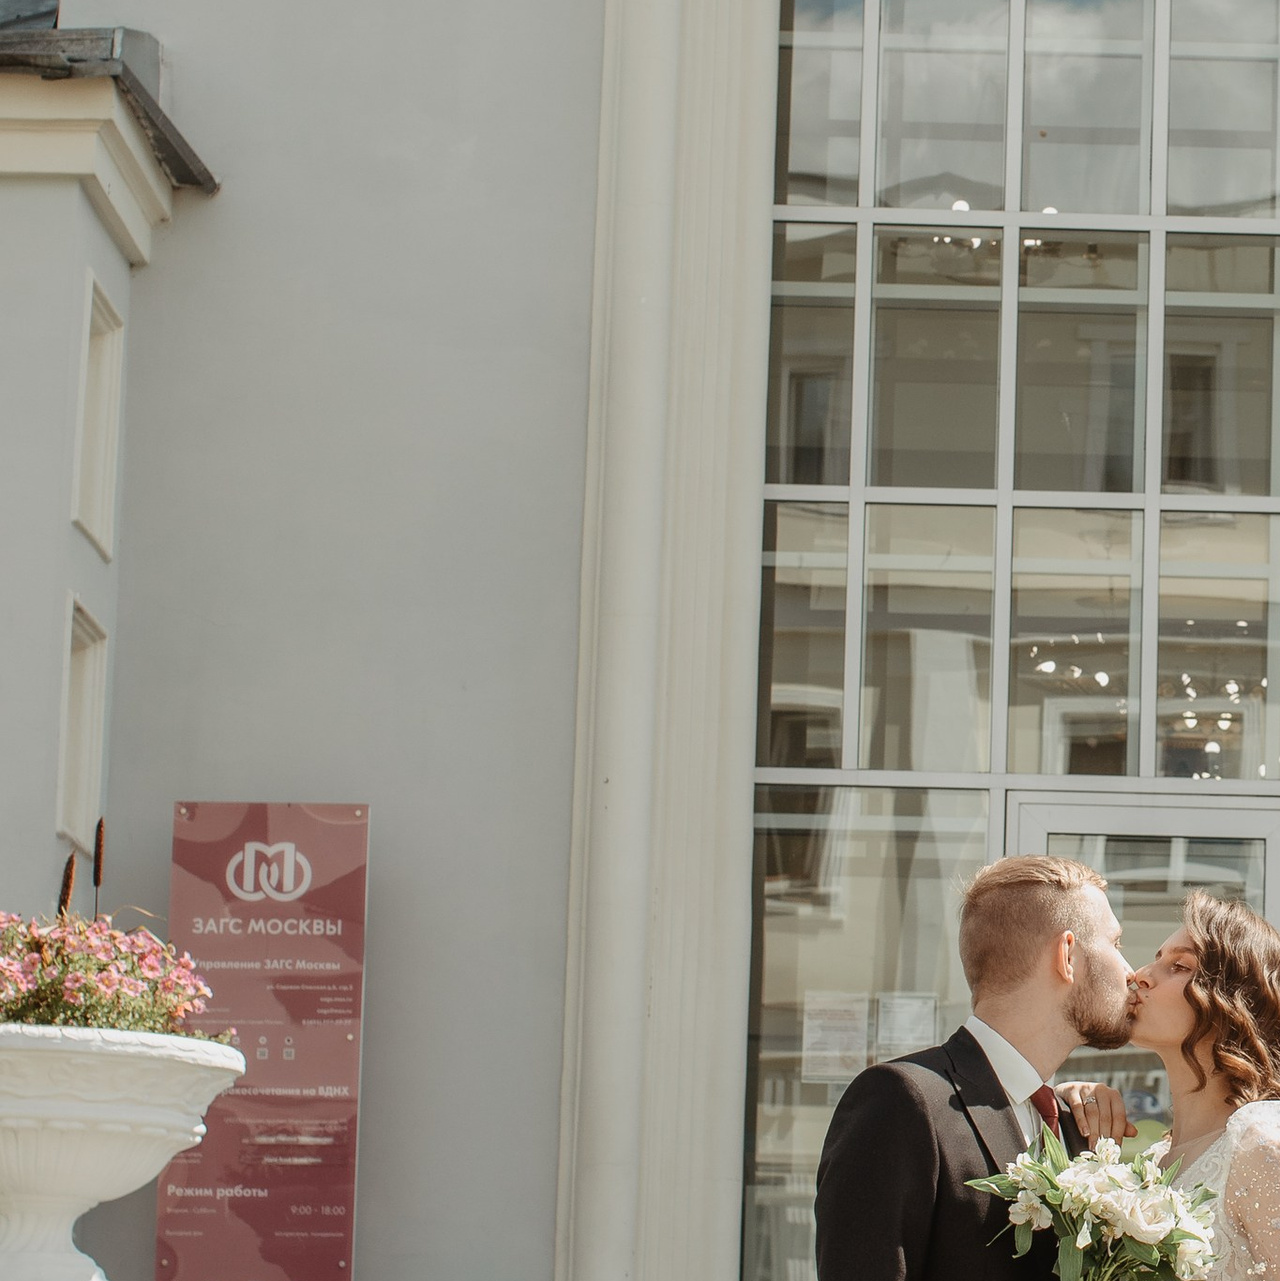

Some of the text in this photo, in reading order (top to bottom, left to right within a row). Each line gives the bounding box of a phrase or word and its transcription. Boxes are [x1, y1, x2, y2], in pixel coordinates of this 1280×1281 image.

[191, 918, 342, 936] ЗАГС МОСКВЫ
[264, 958, 293, 970] ЗАГС
[296, 959, 340, 970] Москвы
[220, 1086, 300, 1098] ракосочетания
[318, 1086, 349, 1097] ВДНХ
[167, 1184, 268, 1200] Режим работы
